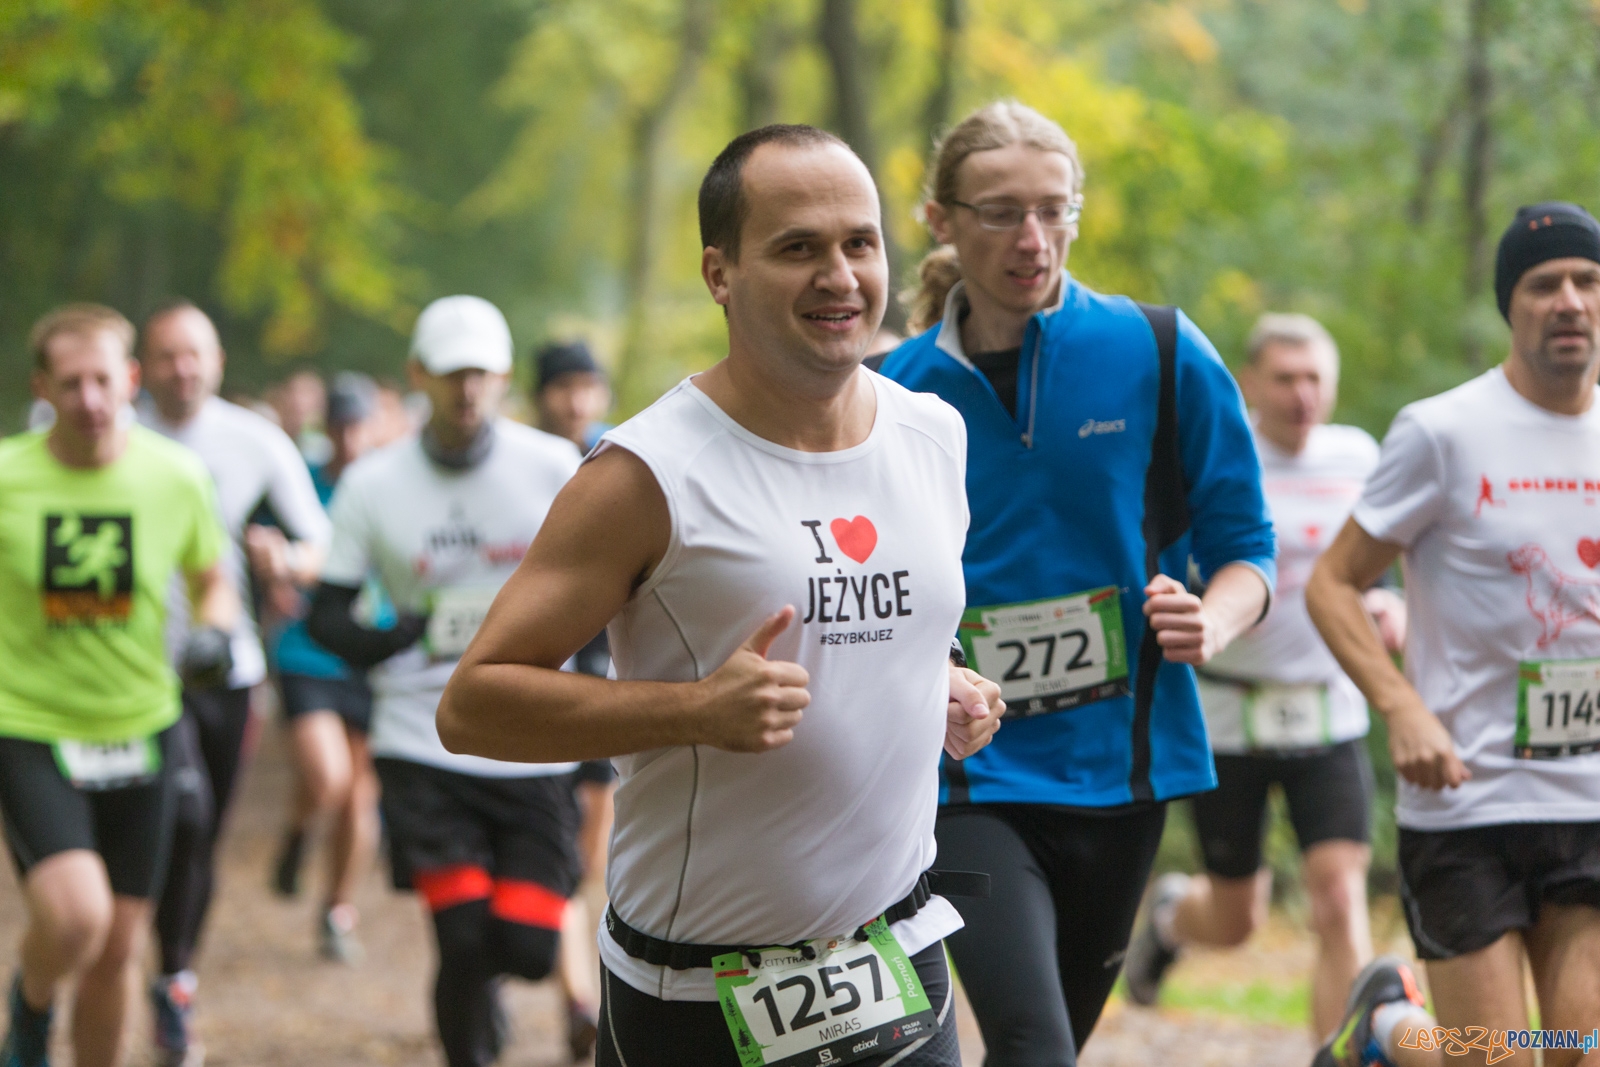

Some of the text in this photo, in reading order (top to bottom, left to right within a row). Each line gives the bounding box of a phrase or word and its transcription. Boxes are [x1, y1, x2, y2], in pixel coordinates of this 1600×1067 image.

[800, 520, 833, 564] I
[803, 568, 912, 624] JEŻYCE
[820, 629, 893, 645] #SZYBKIJEZ
[996, 628, 1094, 682] 272
[764, 956, 807, 968] CITYTRA
[890, 956, 919, 998] Poznań
[752, 953, 884, 1037] 1257
[818, 1018, 862, 1042] MIRAS
[852, 1032, 879, 1053] etixx
